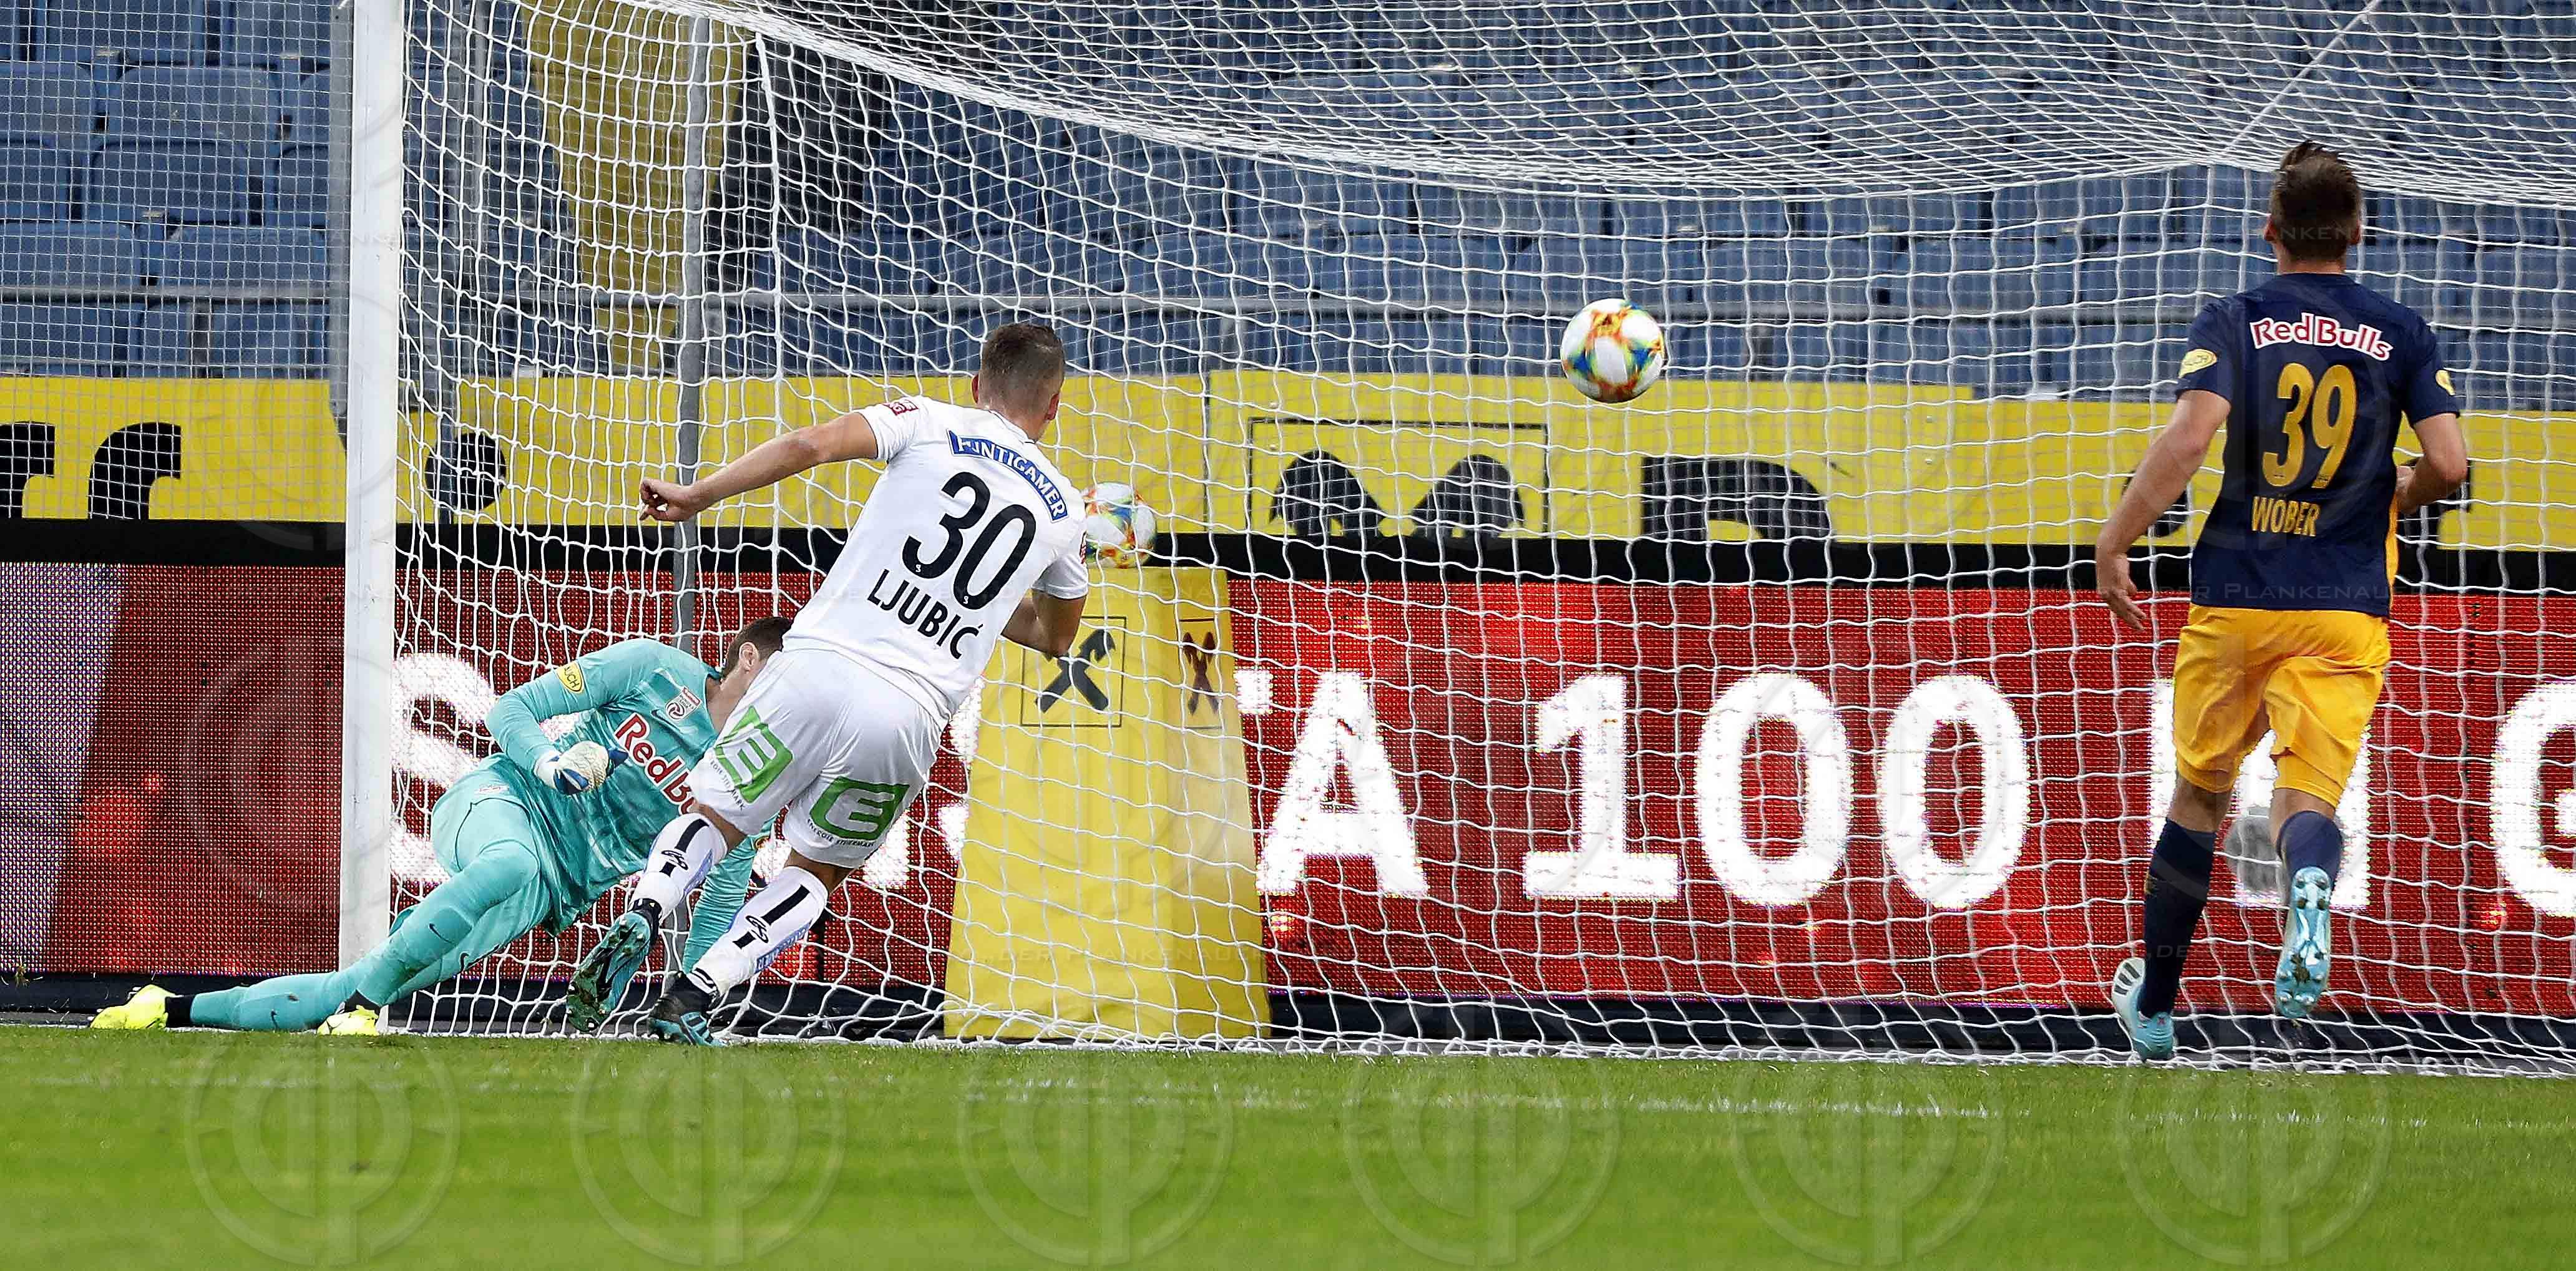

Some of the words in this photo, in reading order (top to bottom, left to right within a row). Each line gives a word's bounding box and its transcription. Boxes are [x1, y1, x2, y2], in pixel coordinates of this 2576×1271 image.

[2261, 362, 2357, 489] 39
[902, 472, 1037, 610] 30
[2252, 493, 2321, 537] WÖBER
[867, 569, 983, 660] LJUBIĆ
[1523, 671, 2031, 907] 100
